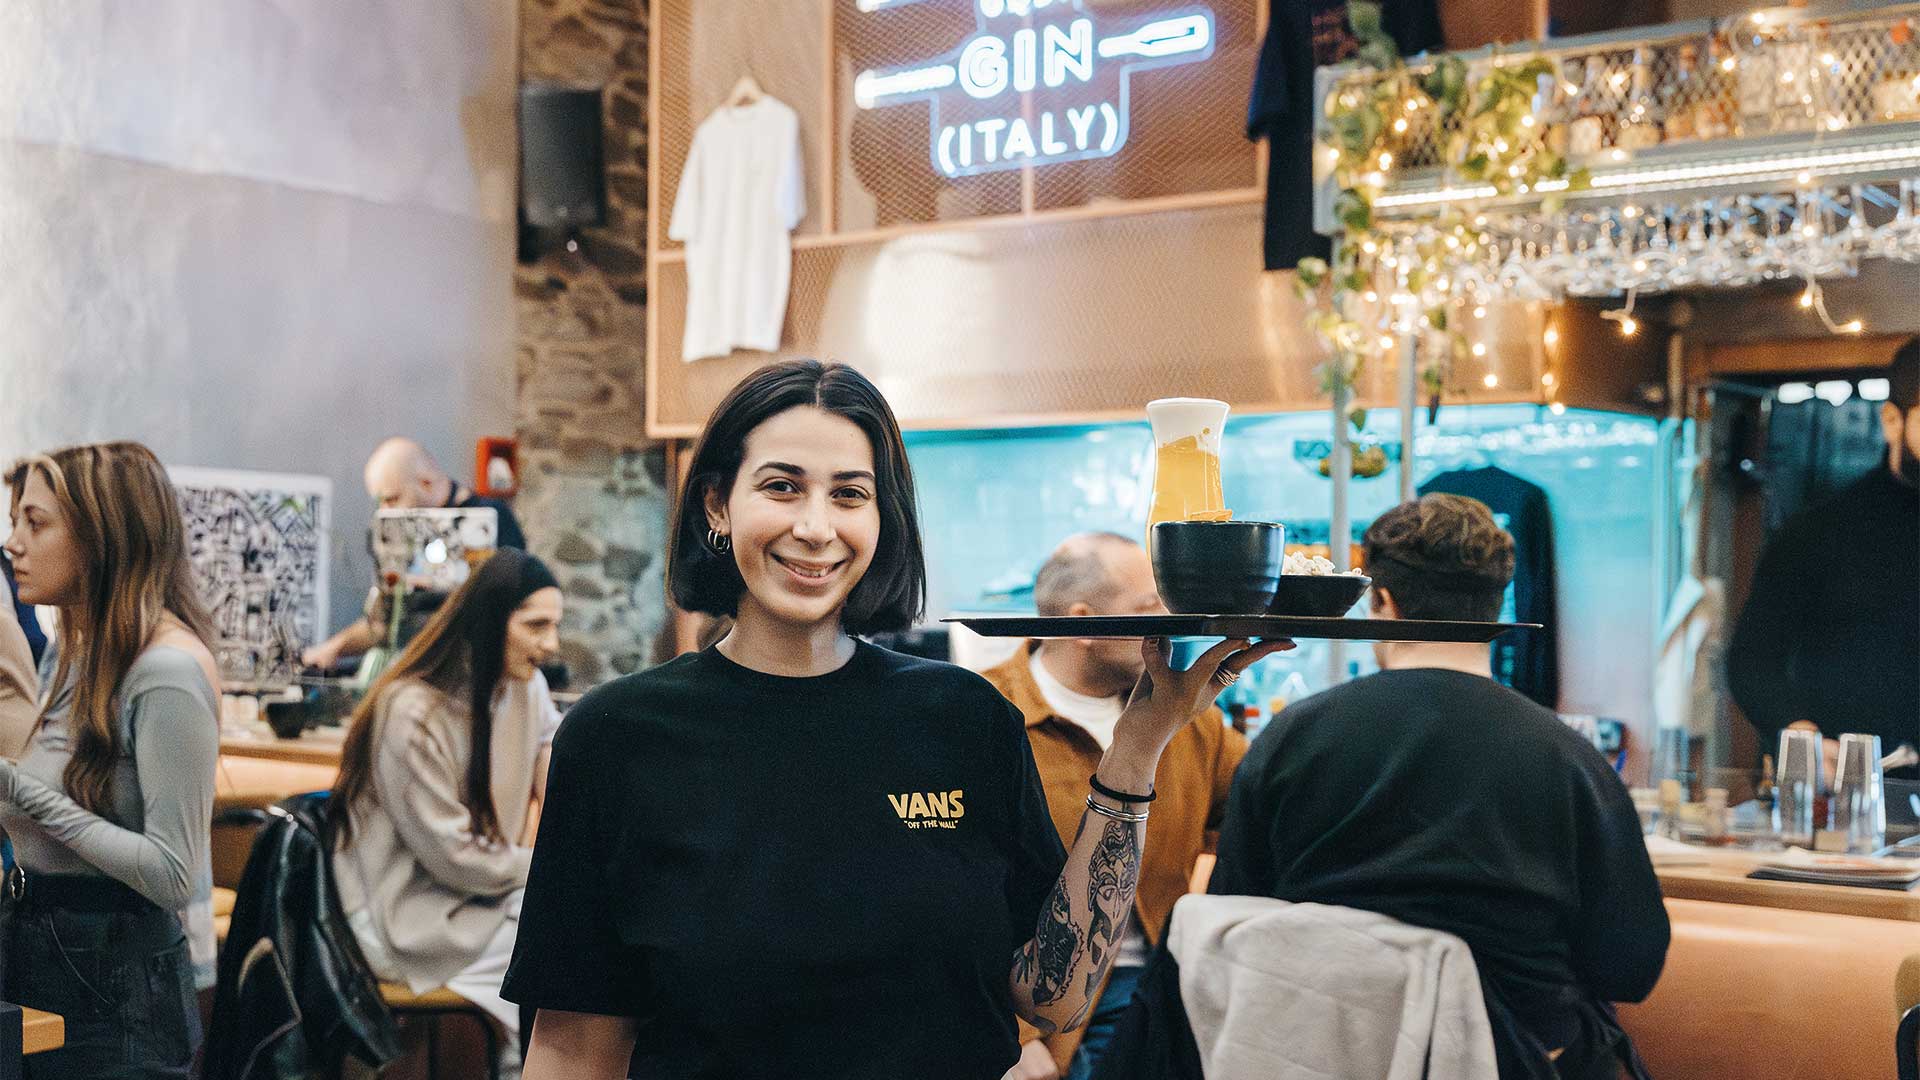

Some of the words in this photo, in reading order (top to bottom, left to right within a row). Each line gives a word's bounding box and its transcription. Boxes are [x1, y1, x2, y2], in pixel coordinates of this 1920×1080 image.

[958, 18, 1093, 98] GIN
[937, 102, 1119, 175] (ITALY)
[887, 790, 965, 818] VANS
[922, 820, 938, 828] THE
